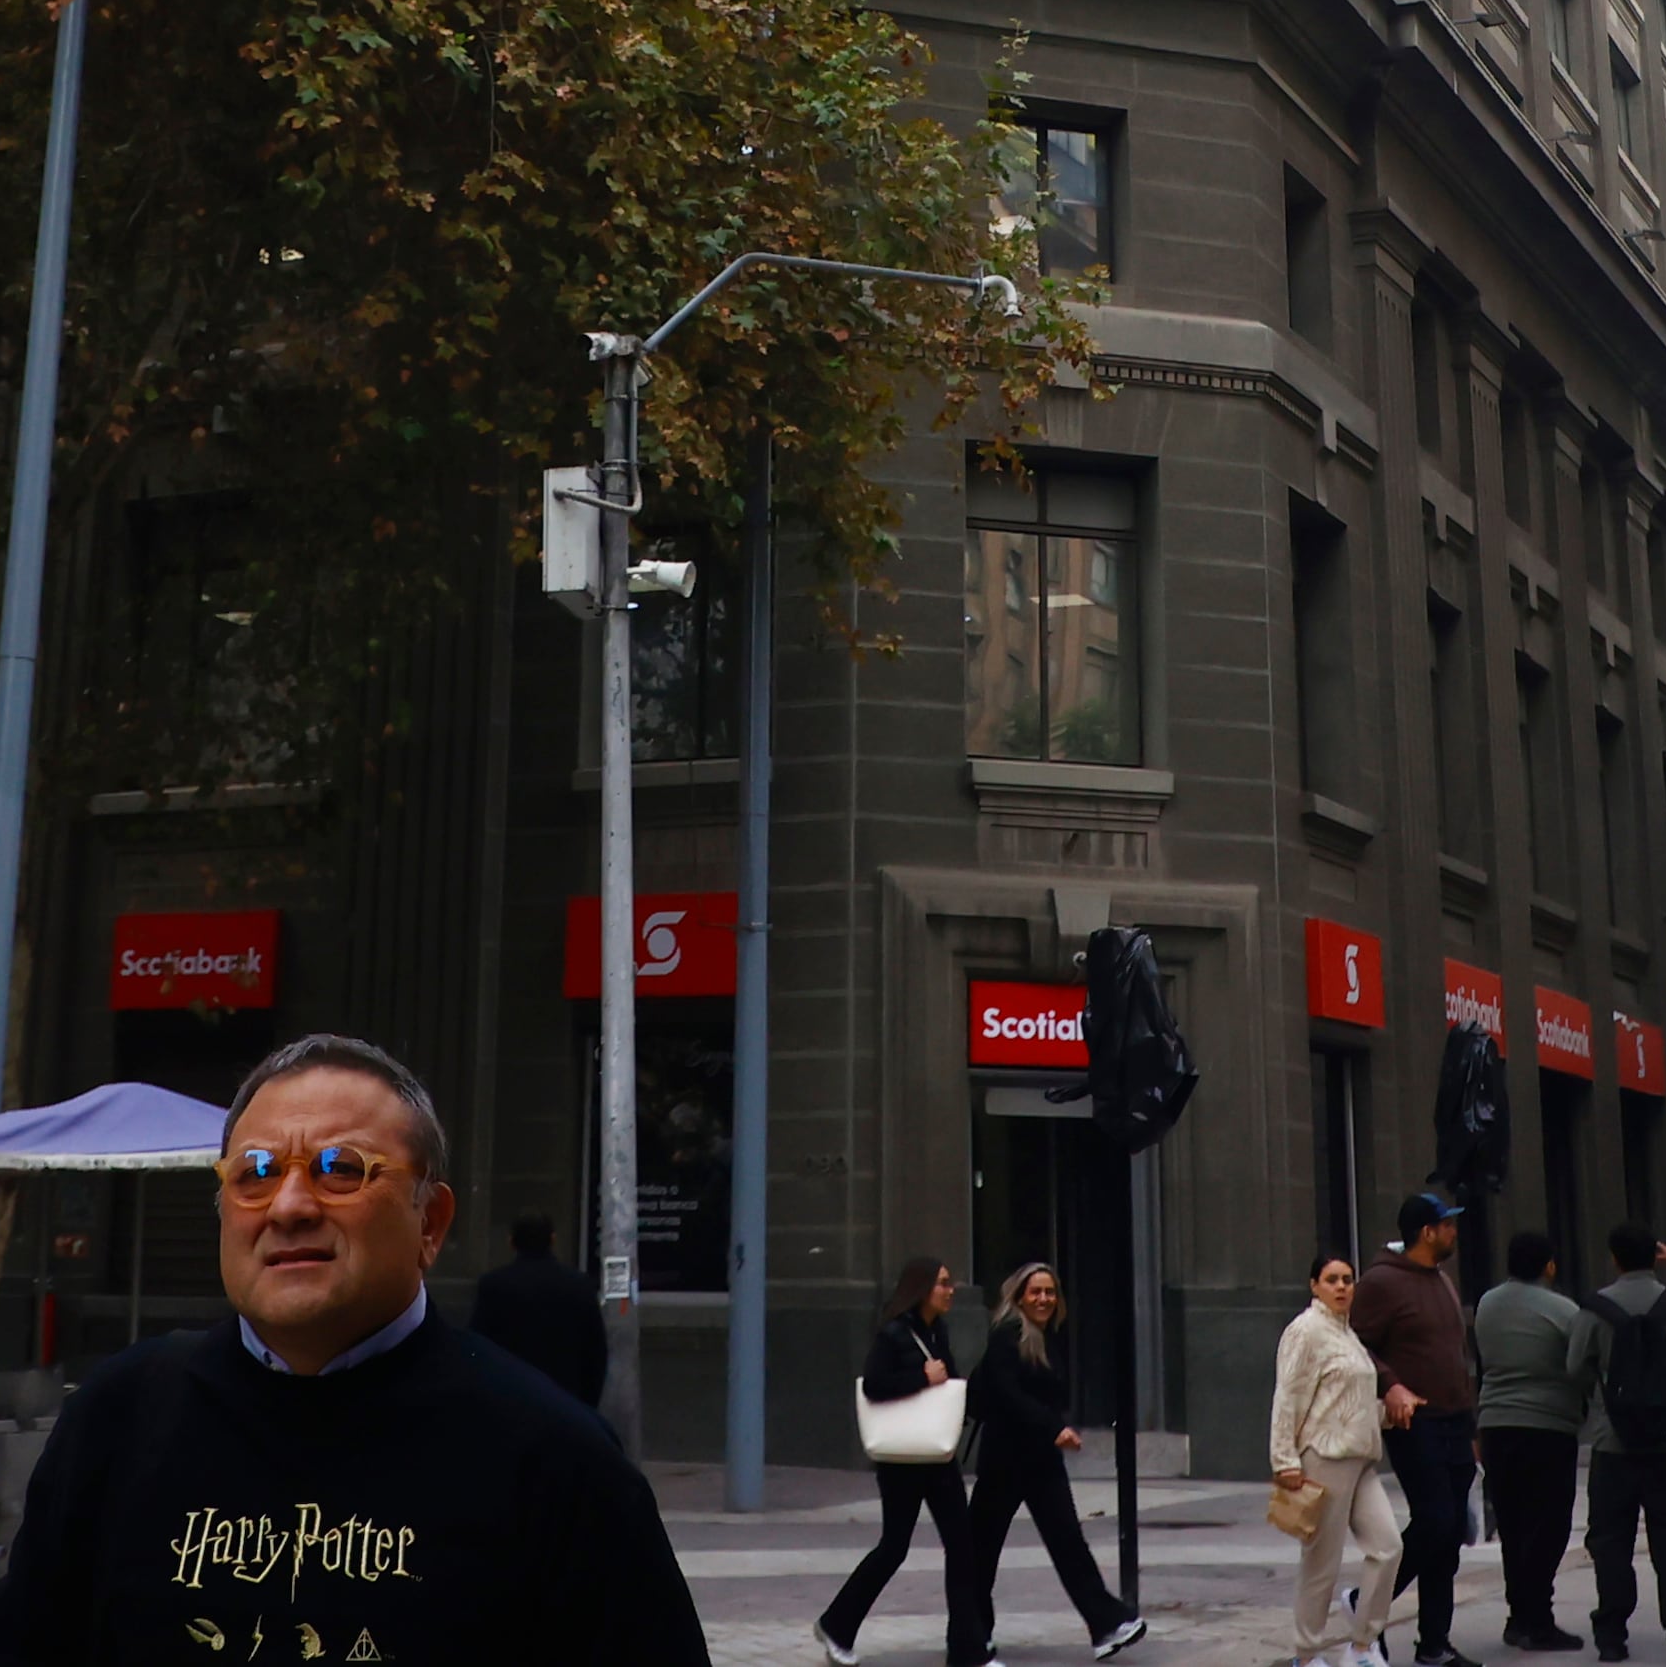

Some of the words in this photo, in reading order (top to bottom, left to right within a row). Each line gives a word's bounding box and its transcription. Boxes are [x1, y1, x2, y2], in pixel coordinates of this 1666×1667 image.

[1537, 1008, 1590, 1058] Scotiabank
[170, 1507, 290, 1589] Harry
[291, 1502, 416, 1605] Potter
